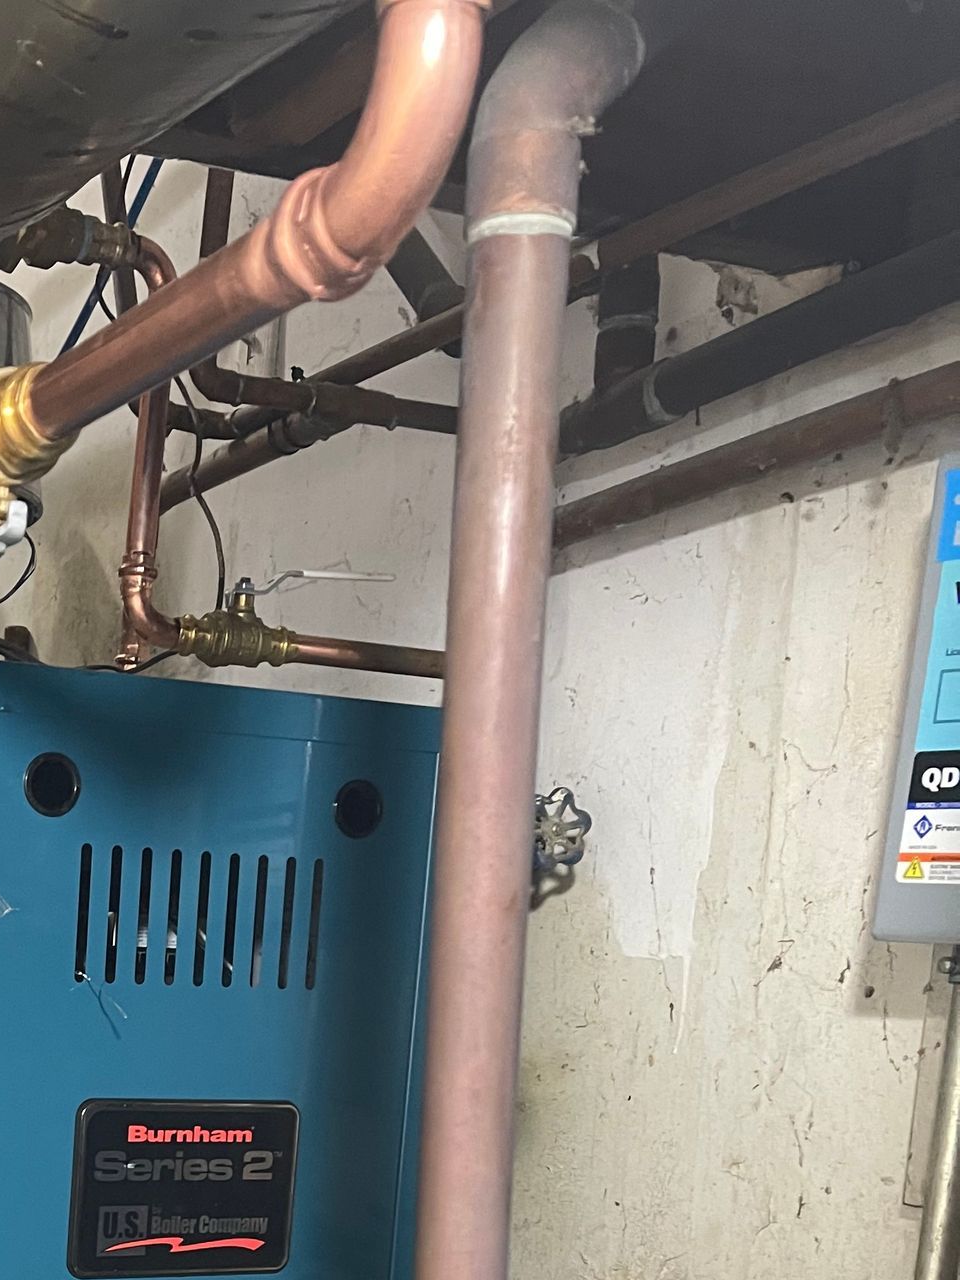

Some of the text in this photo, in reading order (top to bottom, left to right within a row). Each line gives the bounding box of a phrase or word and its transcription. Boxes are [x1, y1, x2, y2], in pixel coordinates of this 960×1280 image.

[127, 1125, 253, 1143] Burnham
[93, 1150, 234, 1182] Series
[103, 1211, 269, 1239] U.S. Boiler Company
